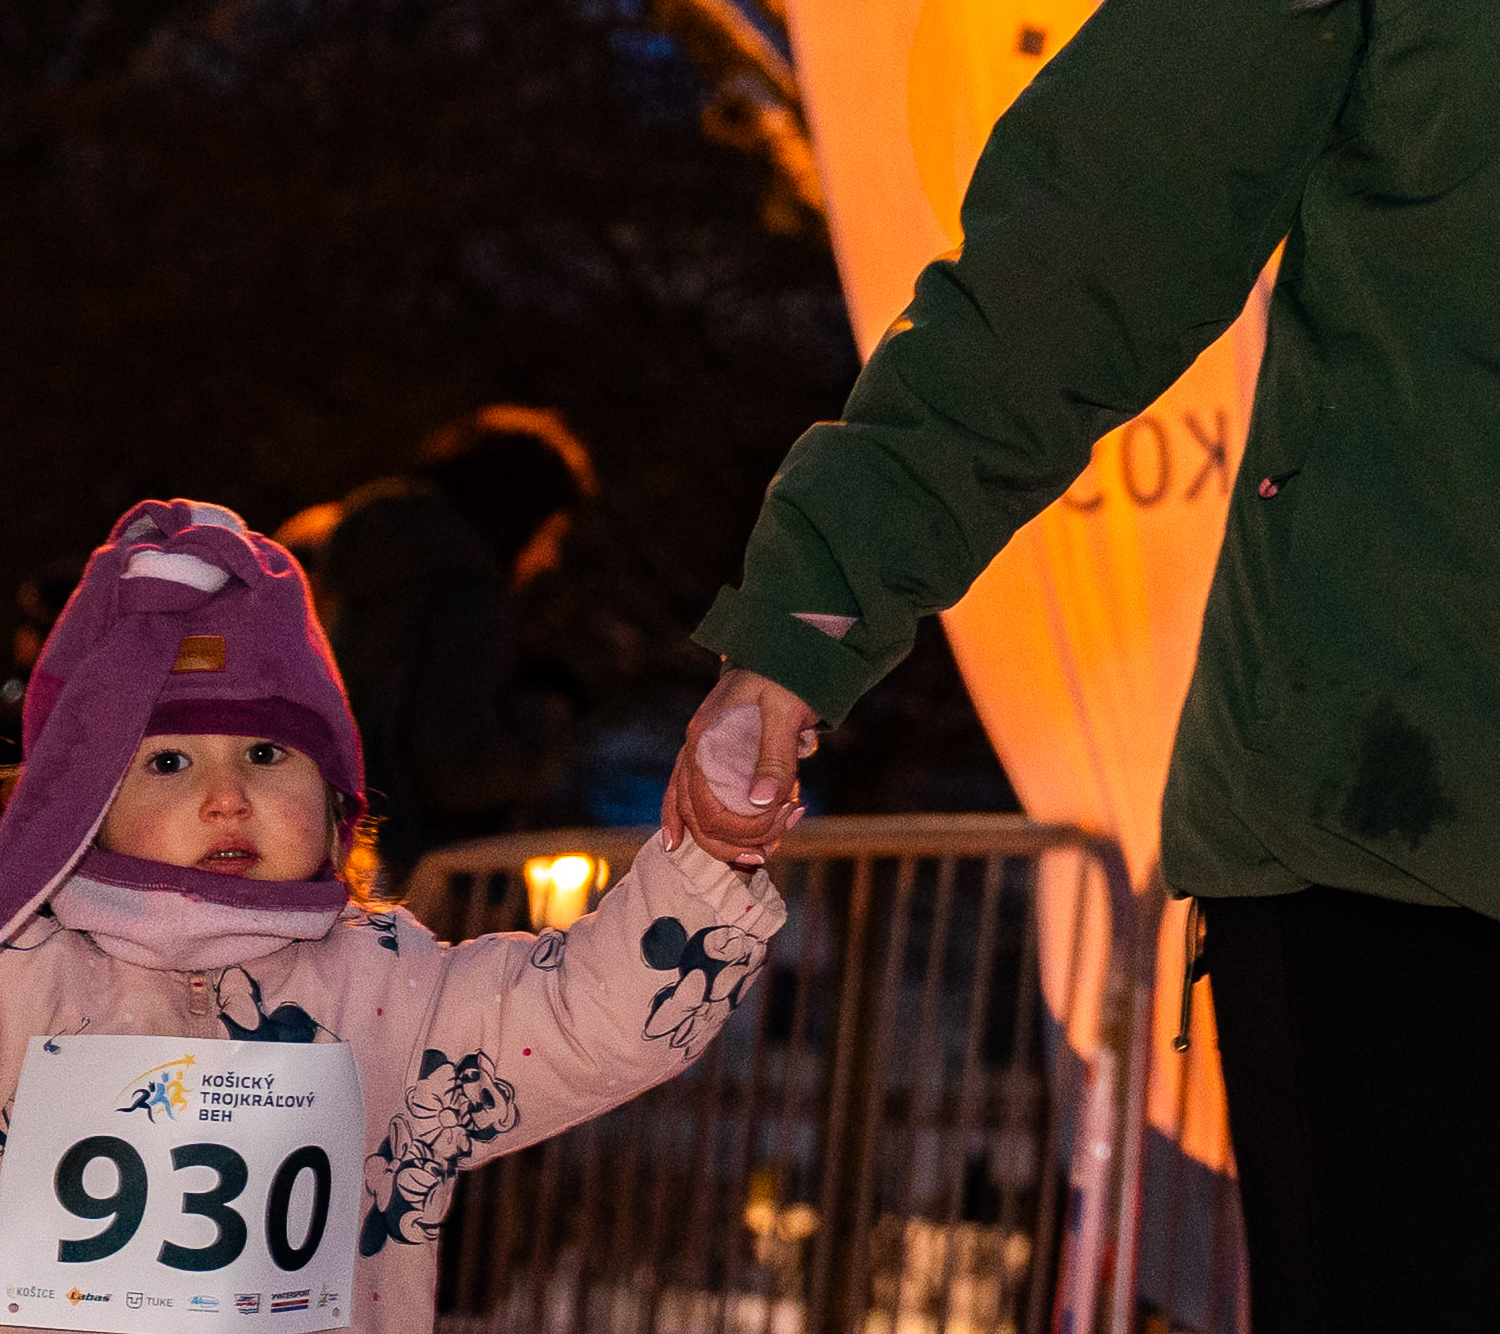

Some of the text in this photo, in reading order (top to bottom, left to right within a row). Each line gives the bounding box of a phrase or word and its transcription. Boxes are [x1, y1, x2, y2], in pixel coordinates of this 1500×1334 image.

[202, 1071, 275, 1090] KOŠICKÝ
[200, 1091, 315, 1109] TROJKRÁĽOVÝ
[199, 1109, 232, 1122] BEH
[54, 1135, 332, 1271] 930
[17, 1286, 55, 1299] KOŠICE
[147, 1297, 173, 1307] TUKE
